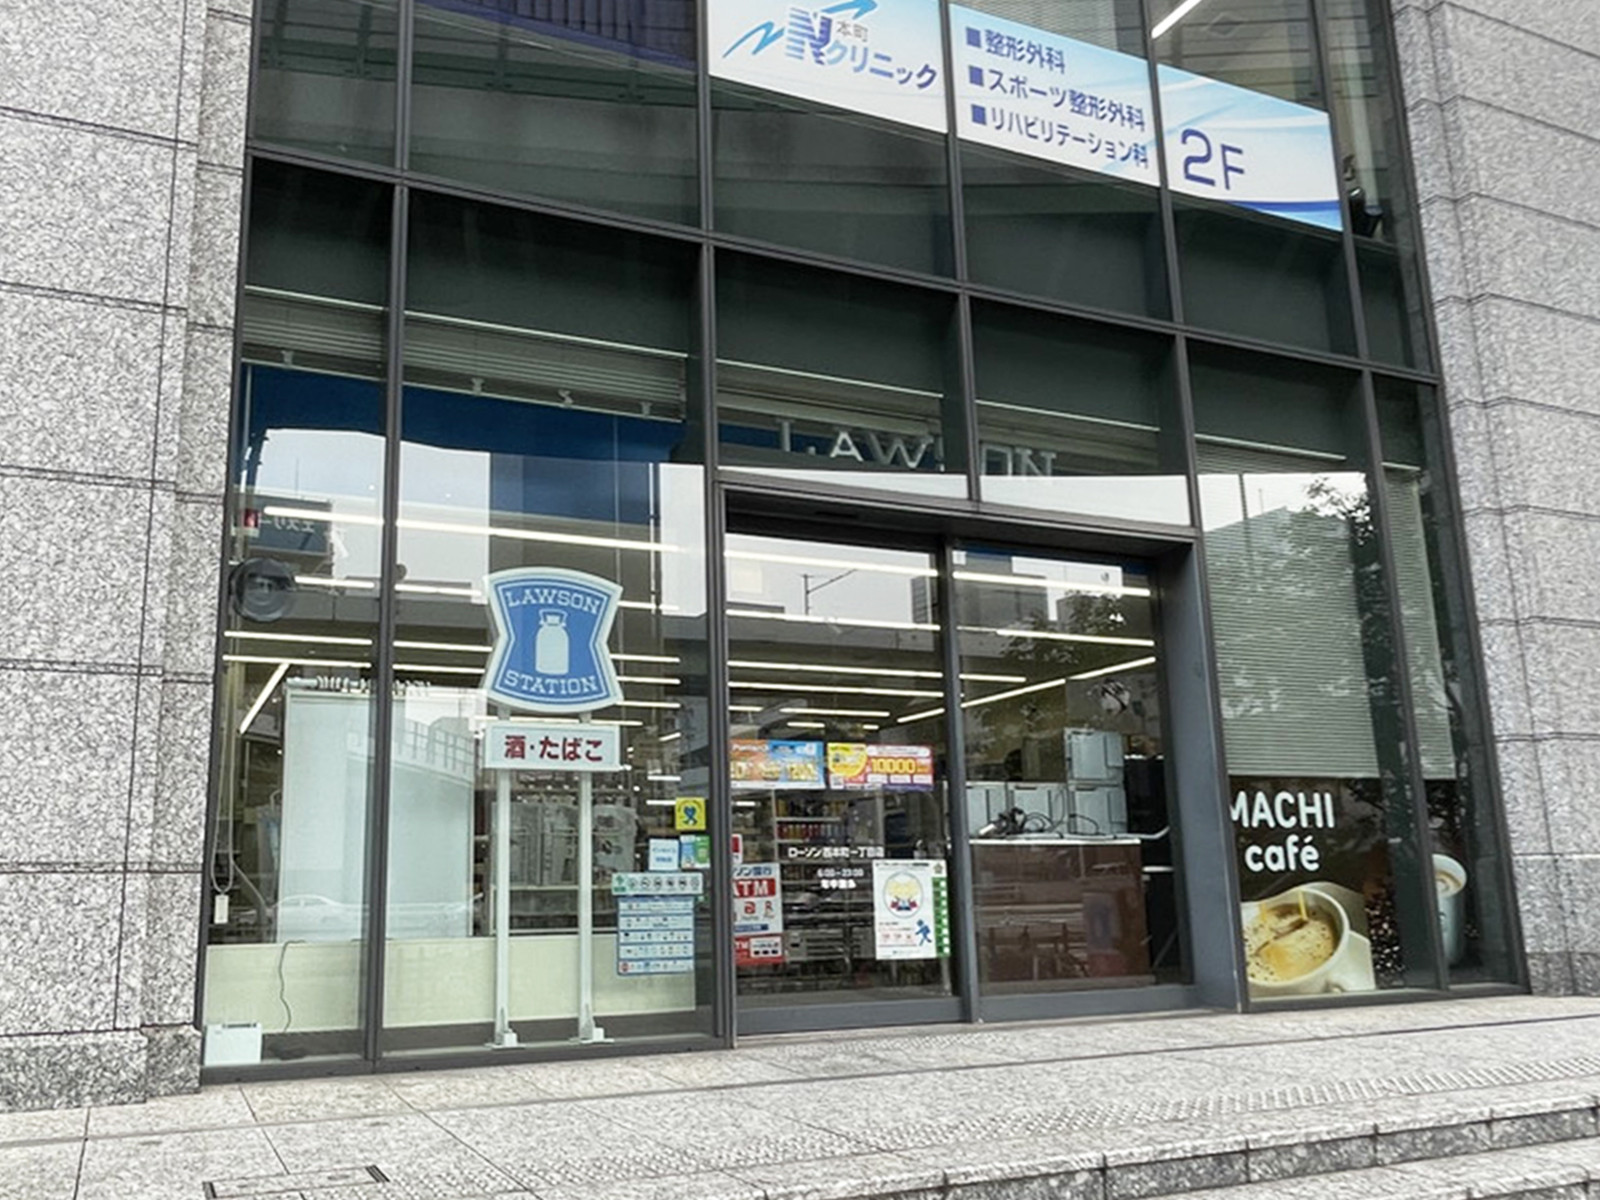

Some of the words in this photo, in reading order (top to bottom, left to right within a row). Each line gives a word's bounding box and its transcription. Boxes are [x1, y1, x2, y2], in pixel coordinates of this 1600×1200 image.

[826, 39, 938, 90] クリニック
[984, 28, 1066, 75] 整形外科
[988, 68, 1146, 132] スポーツ整形外科
[990, 105, 1150, 170] リハビリテーション科
[1182, 128, 1246, 191] 2F
[505, 588, 601, 615] LAWSON
[504, 669, 599, 695] STATION
[504, 734, 603, 762] 酒・たばこ
[1230, 790, 1336, 829] MACHI
[1245, 834, 1321, 873] café
